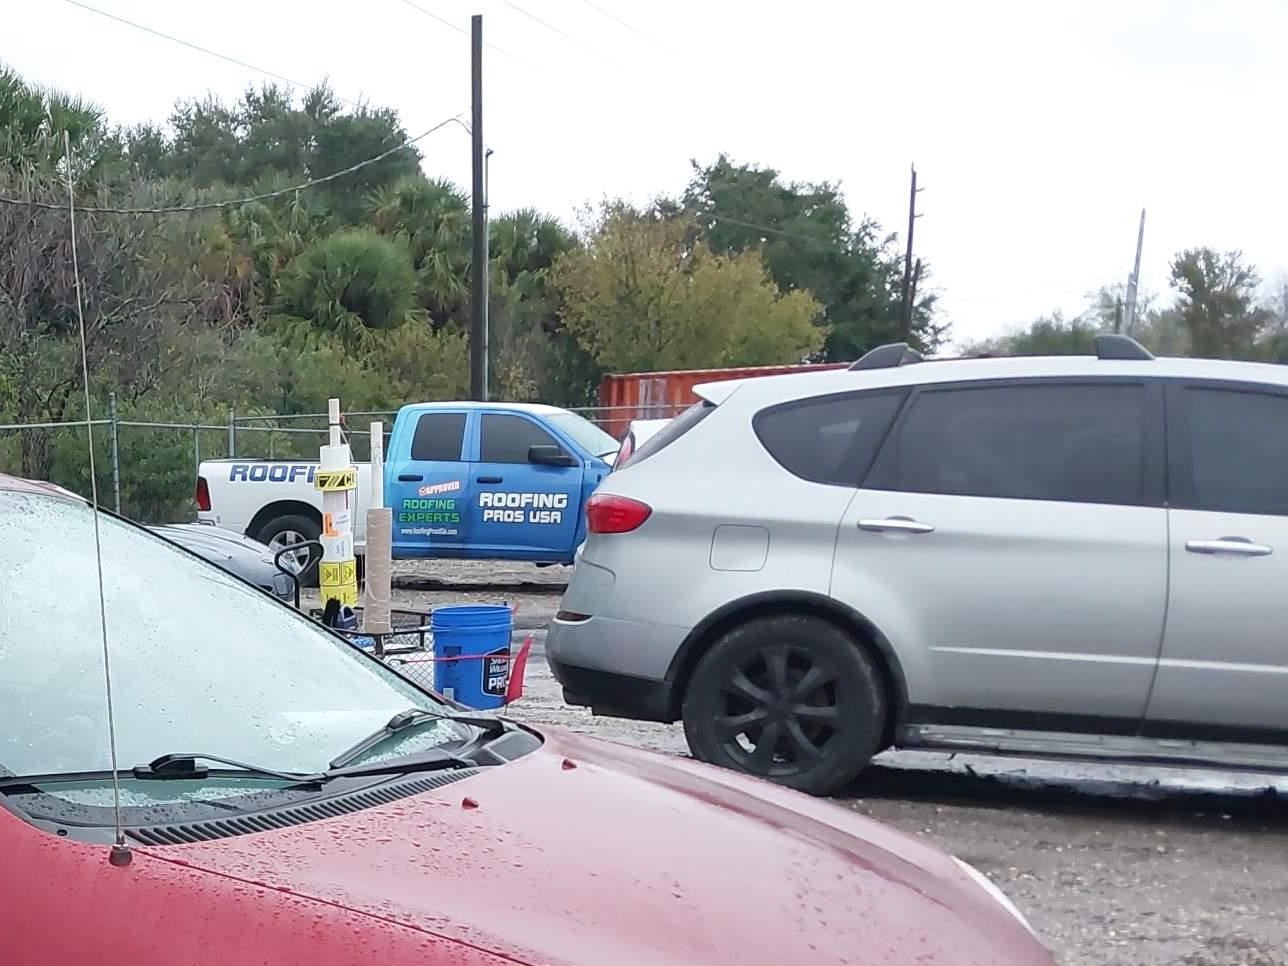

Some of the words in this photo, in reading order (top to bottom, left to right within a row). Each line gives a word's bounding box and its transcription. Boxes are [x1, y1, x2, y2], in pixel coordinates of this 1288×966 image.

[229, 464, 318, 482] ROOFI
[402, 499, 456, 510] ROOFING
[479, 492, 569, 508] ROOFING
[398, 512, 461, 523] EXPERTS
[483, 510, 524, 523] PROS
[529, 511, 562, 524] USA
